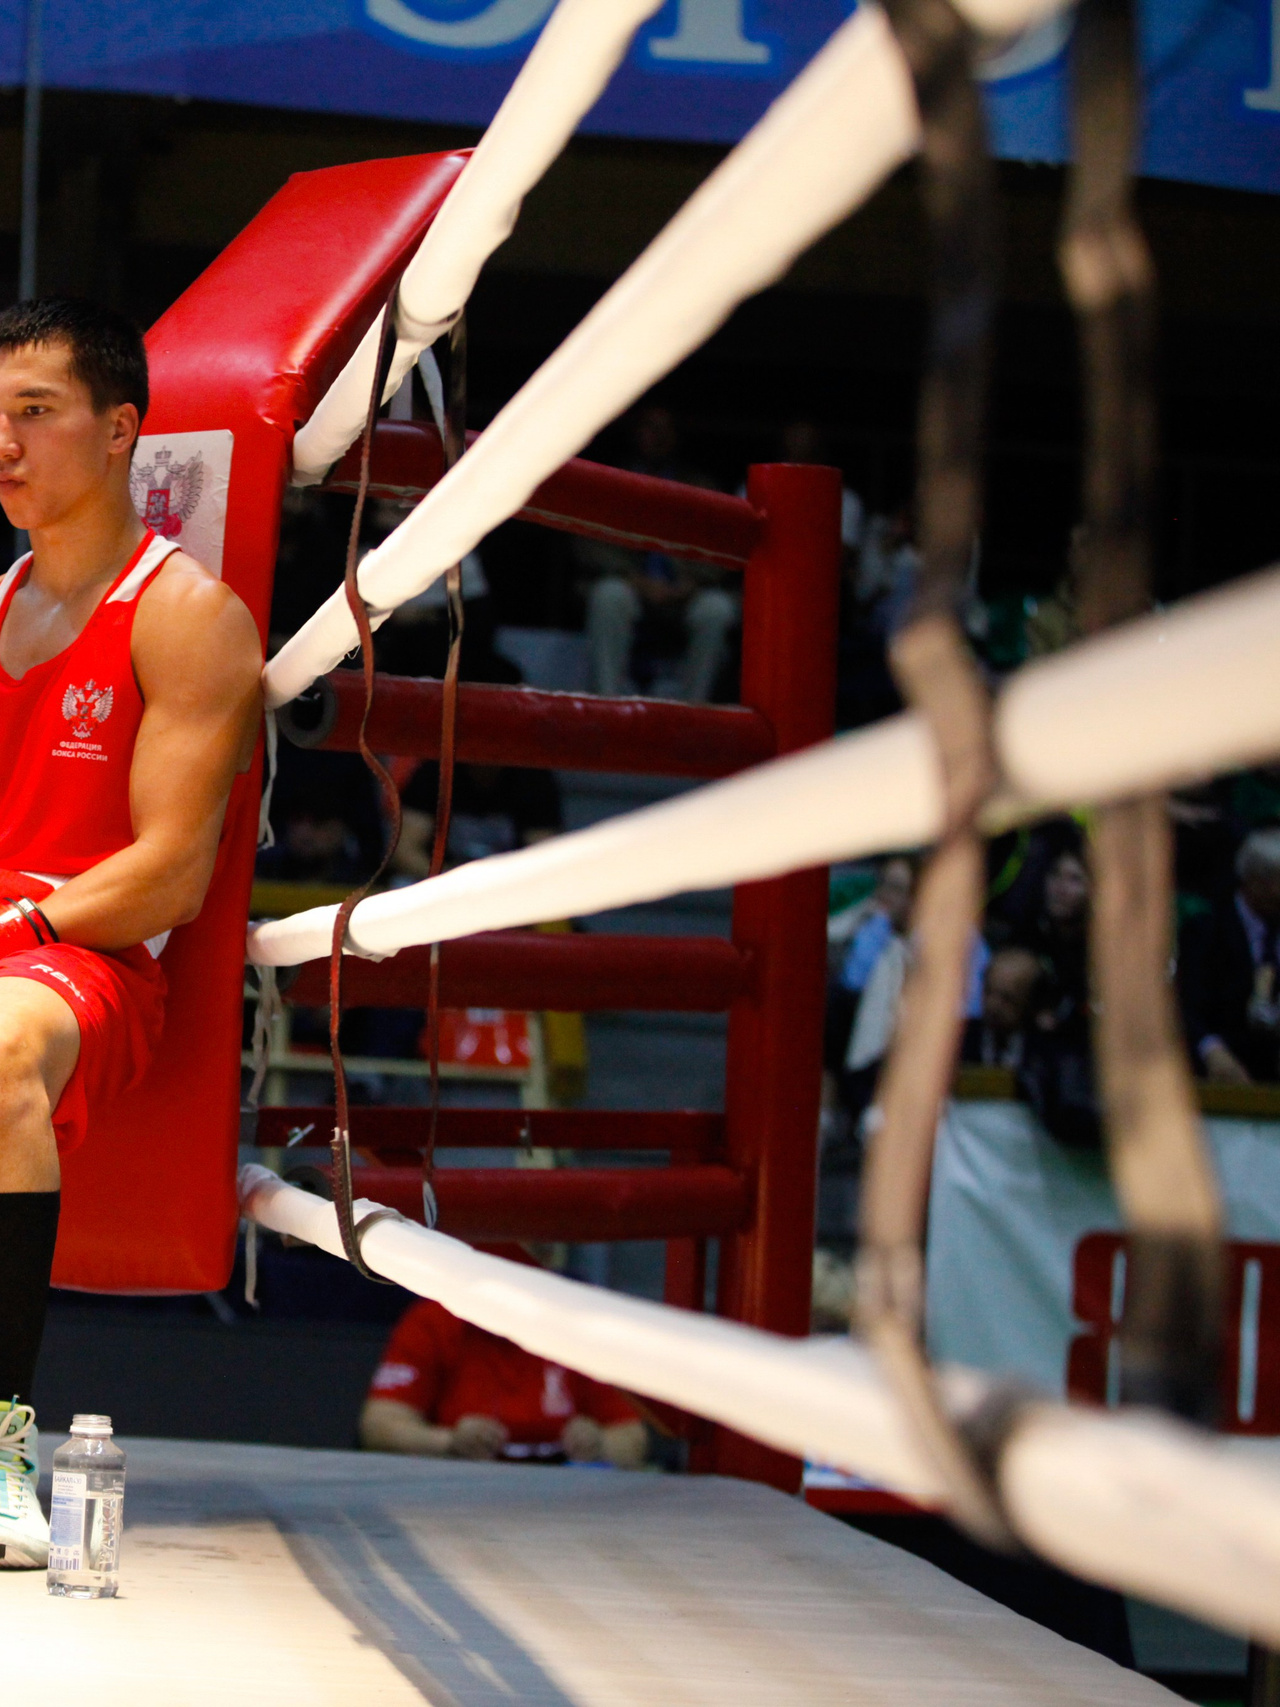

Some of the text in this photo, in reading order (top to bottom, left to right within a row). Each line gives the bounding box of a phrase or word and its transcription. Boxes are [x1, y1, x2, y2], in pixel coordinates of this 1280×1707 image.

[59, 740, 102, 752] ФЕДЕРАЦИЯ
[51, 749, 108, 762] БОКСА РОССИИ
